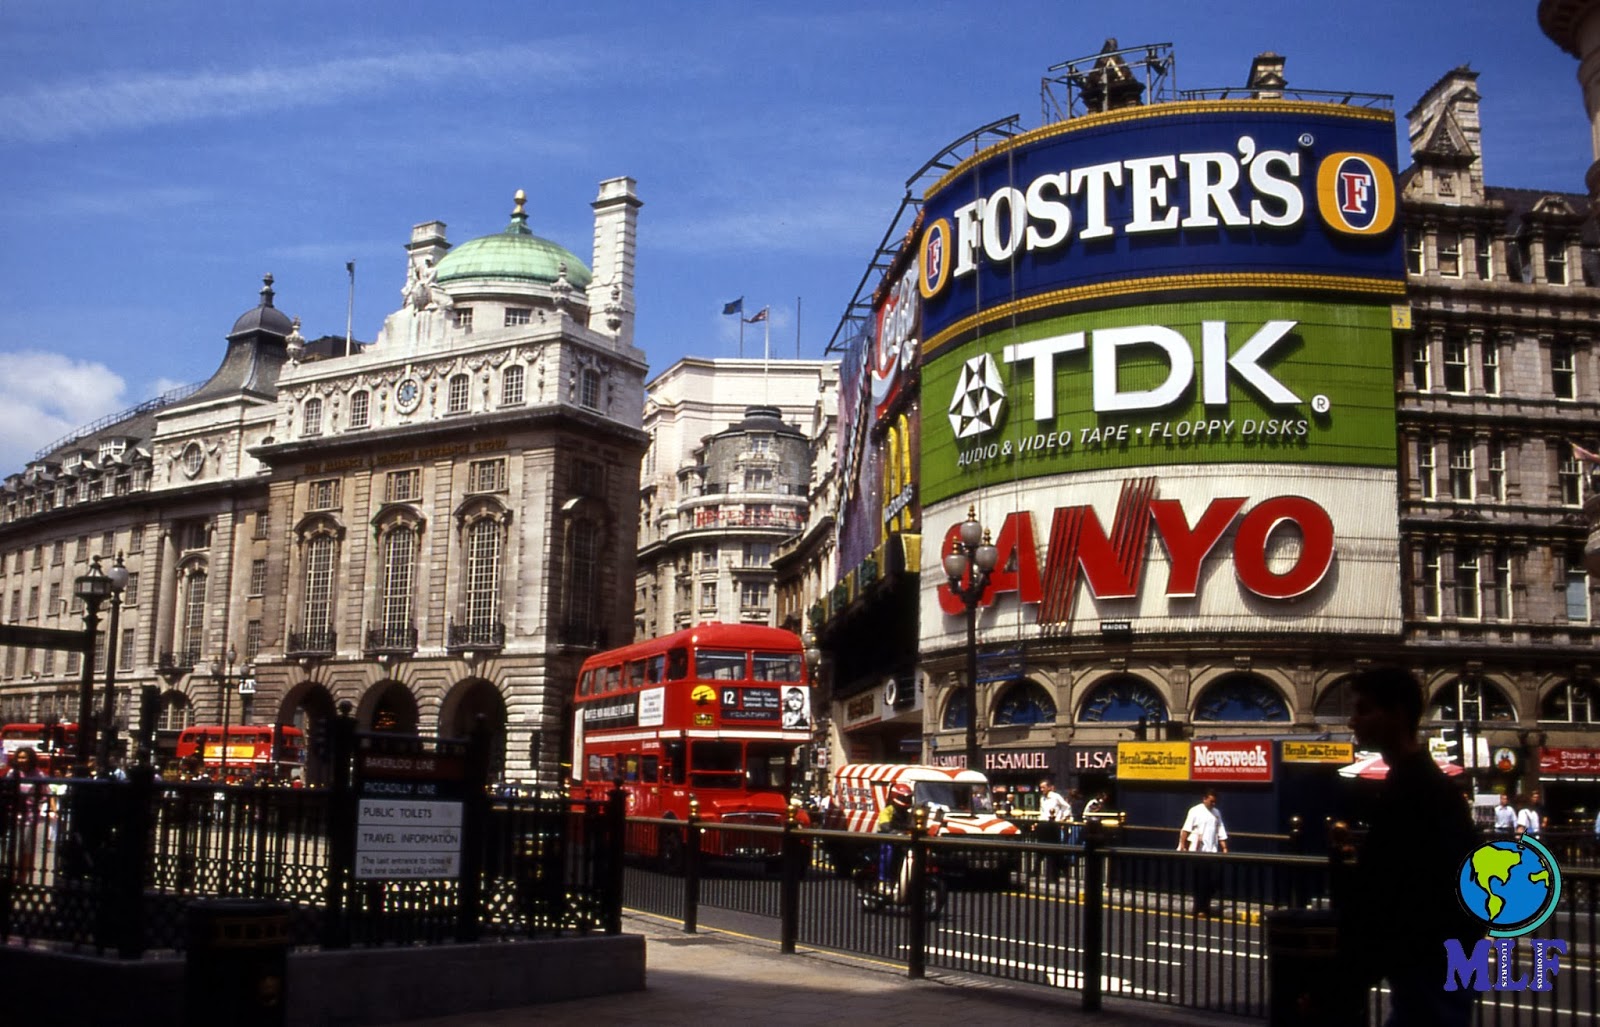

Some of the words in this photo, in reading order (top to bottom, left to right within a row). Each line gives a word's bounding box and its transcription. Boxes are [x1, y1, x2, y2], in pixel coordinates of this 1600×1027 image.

[953, 136, 1304, 278] FOSTER'S
[1003, 320, 1303, 422] TDK
[957, 443, 998, 467] AUDIO
[1001, 440, 1013, 456] &
[1017, 430, 1072, 452] VIDEO
[1080, 424, 1129, 444] TAPE
[1148, 419, 1235, 437] FLOPPY
[1241, 419, 1308, 435] DISKS
[937, 476, 1335, 627] SANYO
[723, 691, 735, 704] 12
[985, 752, 1049, 769] H.SAMUEL
[1119, 751, 1140, 764] Herald
[1157, 751, 1187, 765] Tribune
[1193, 745, 1268, 766] Newsweek
[365, 757, 412, 769] BAKERLOO
[415, 759, 436, 770] LINE
[363, 782, 412, 793] PICCADILLY
[417, 784, 436, 794] LINE
[363, 807, 394, 818] PUBLIC
[400, 808, 432, 818] TOILETS
[363, 833, 396, 843] TRAVEL
[401, 834, 458, 844] INFORMATION
[362, 856, 375, 864] The
[391, 856, 418, 864] entrance
